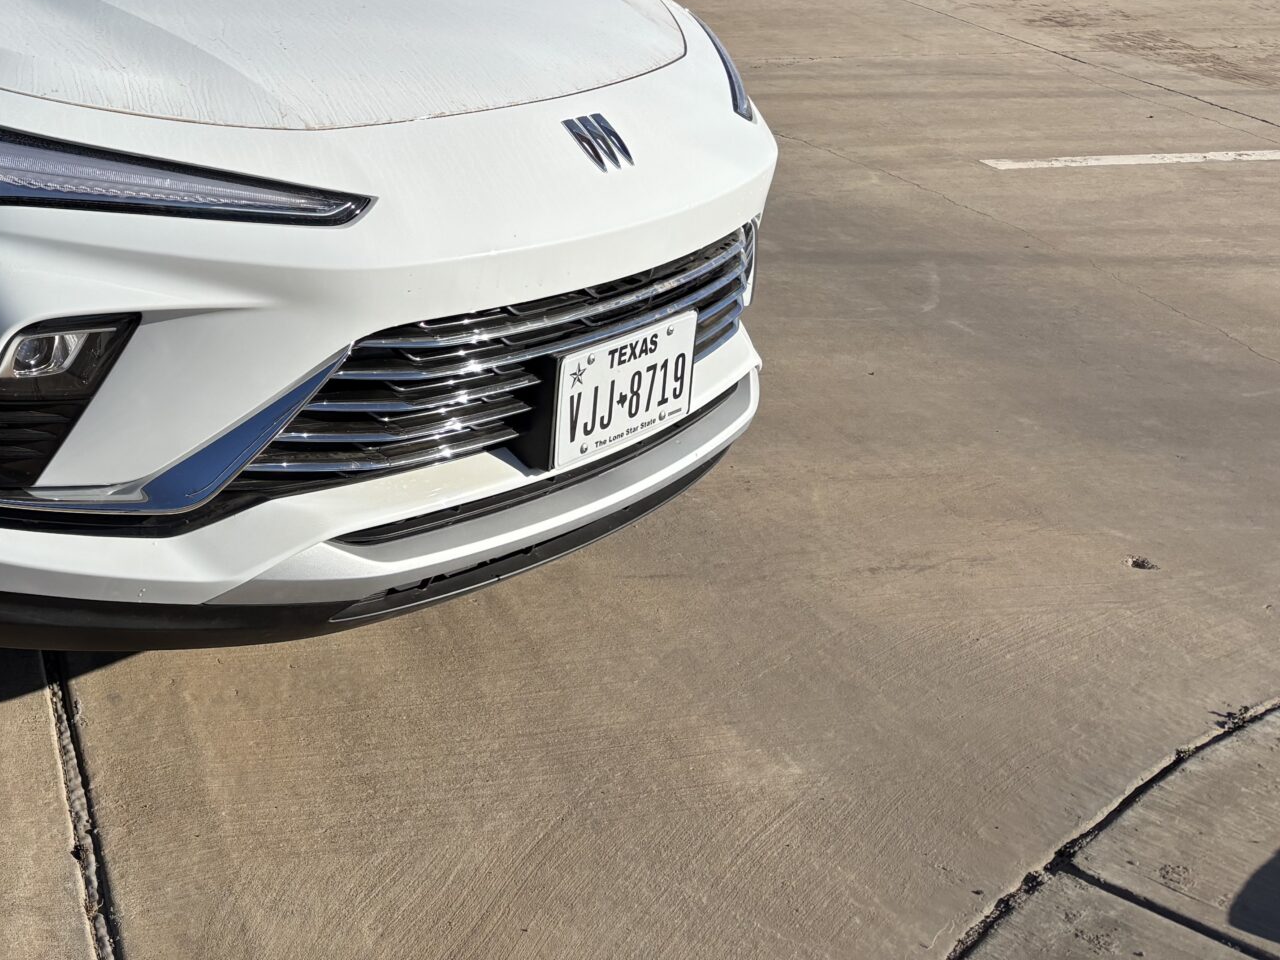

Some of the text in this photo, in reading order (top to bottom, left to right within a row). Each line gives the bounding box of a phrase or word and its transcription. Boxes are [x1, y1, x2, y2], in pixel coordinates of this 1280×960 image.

[608, 333, 659, 369] TEXAS
[627, 352, 686, 419] 8719
[595, 418, 657, 448] The Lone Star State
